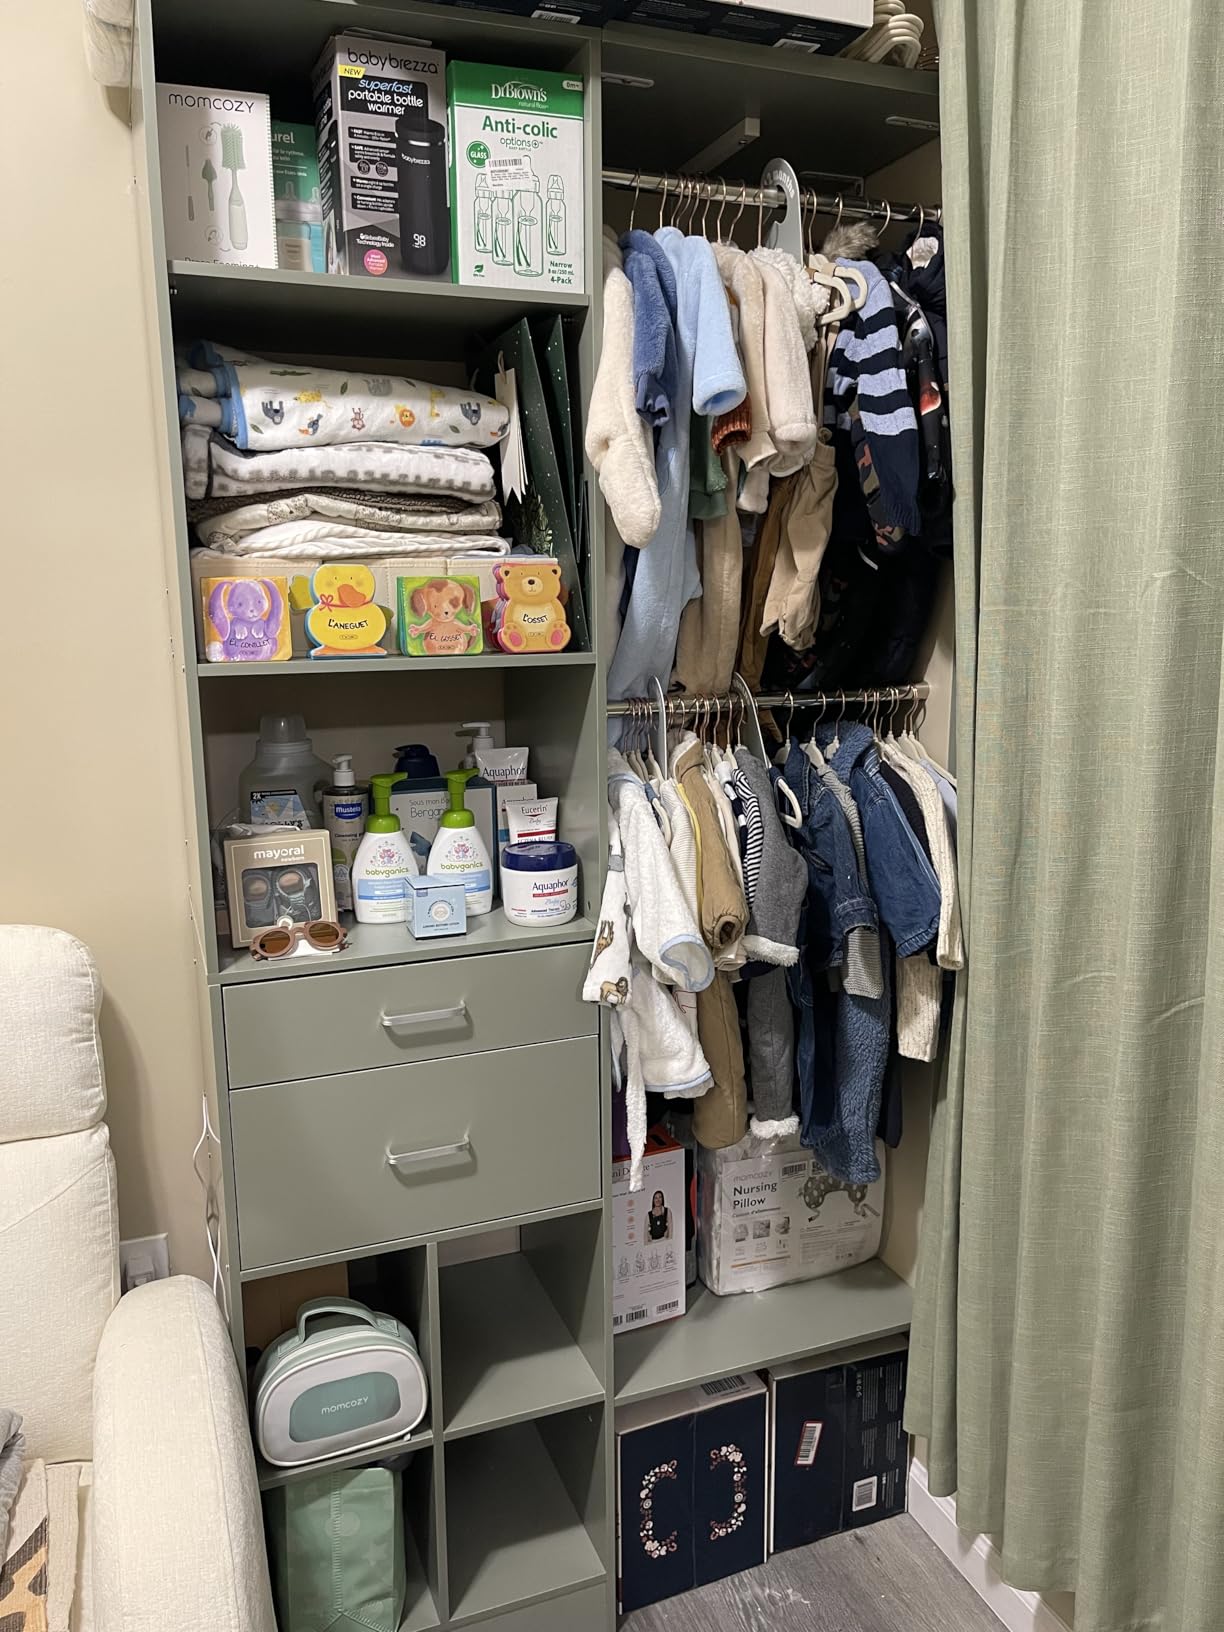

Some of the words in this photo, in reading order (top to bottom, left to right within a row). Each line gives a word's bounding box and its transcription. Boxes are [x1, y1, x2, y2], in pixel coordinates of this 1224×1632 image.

[359, 79, 413, 93] superfast
[348, 90, 392, 103] portable
[394, 93, 424, 107] bottle
[367, 103, 405, 115] warmer
[482, 115, 559, 139] Anti-colic
[470, 151, 487, 160] GLASS
[413, 233, 426, 247] 98
[550, 260, 573, 269] Narrow
[550, 276, 572, 284] 4-Pack
[328, 618, 368, 630] L'ANEGUET
[522, 613, 548, 623] L'OSSET
[482, 765, 526, 779] Aquaphor
[252, 792, 261, 800] 2X
[521, 805, 547, 814] Eucerin
[254, 844, 304, 859] mayoral
[365, 866, 409, 878] babyganics
[441, 861, 484, 872] babyganics
[532, 879, 568, 892] Aquaphor
[733, 1182, 778, 1196] Nursing
[733, 1198, 766, 1209] Pillow
